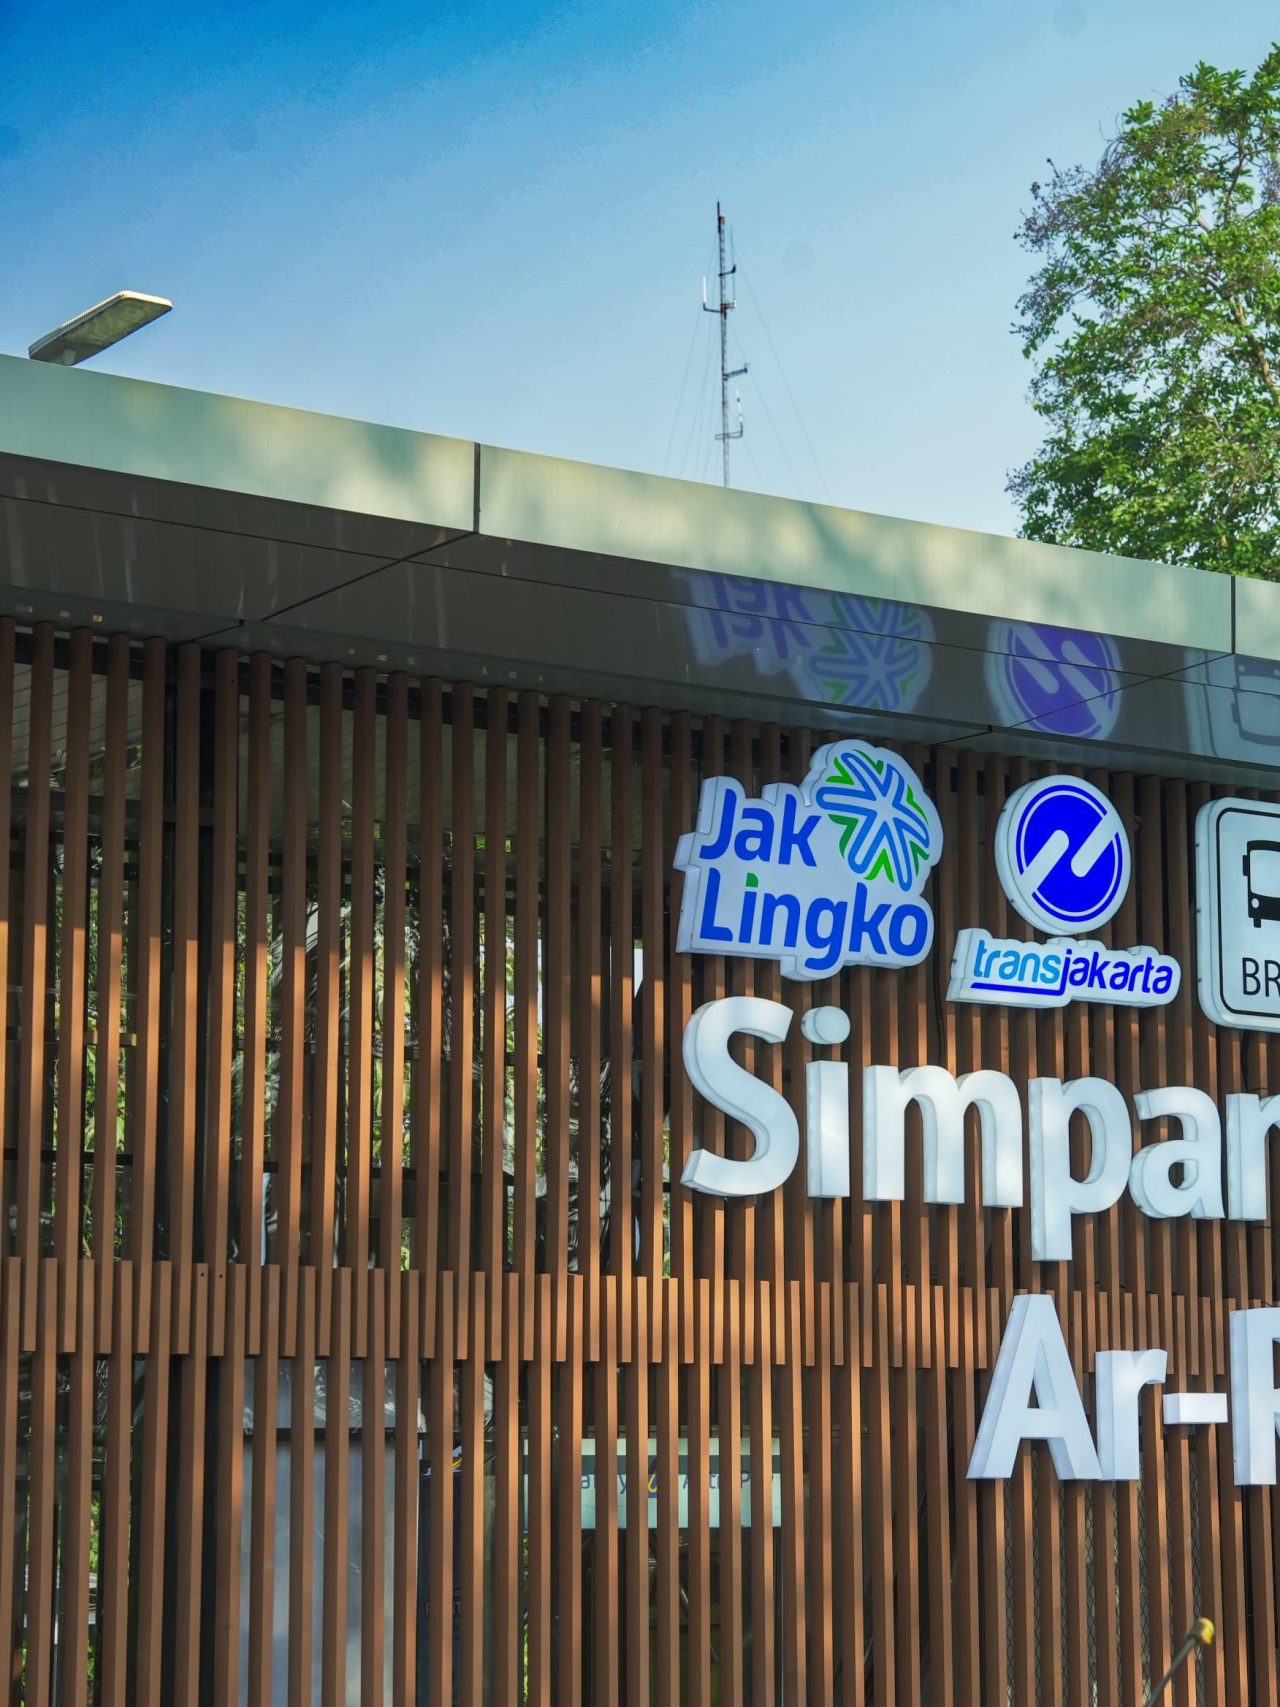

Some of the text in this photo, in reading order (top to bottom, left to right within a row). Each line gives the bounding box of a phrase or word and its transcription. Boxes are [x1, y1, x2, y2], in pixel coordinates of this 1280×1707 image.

[699, 788, 822, 867] Jak
[699, 867, 928, 970] Lingko
[971, 939, 1173, 996] transjakarta
